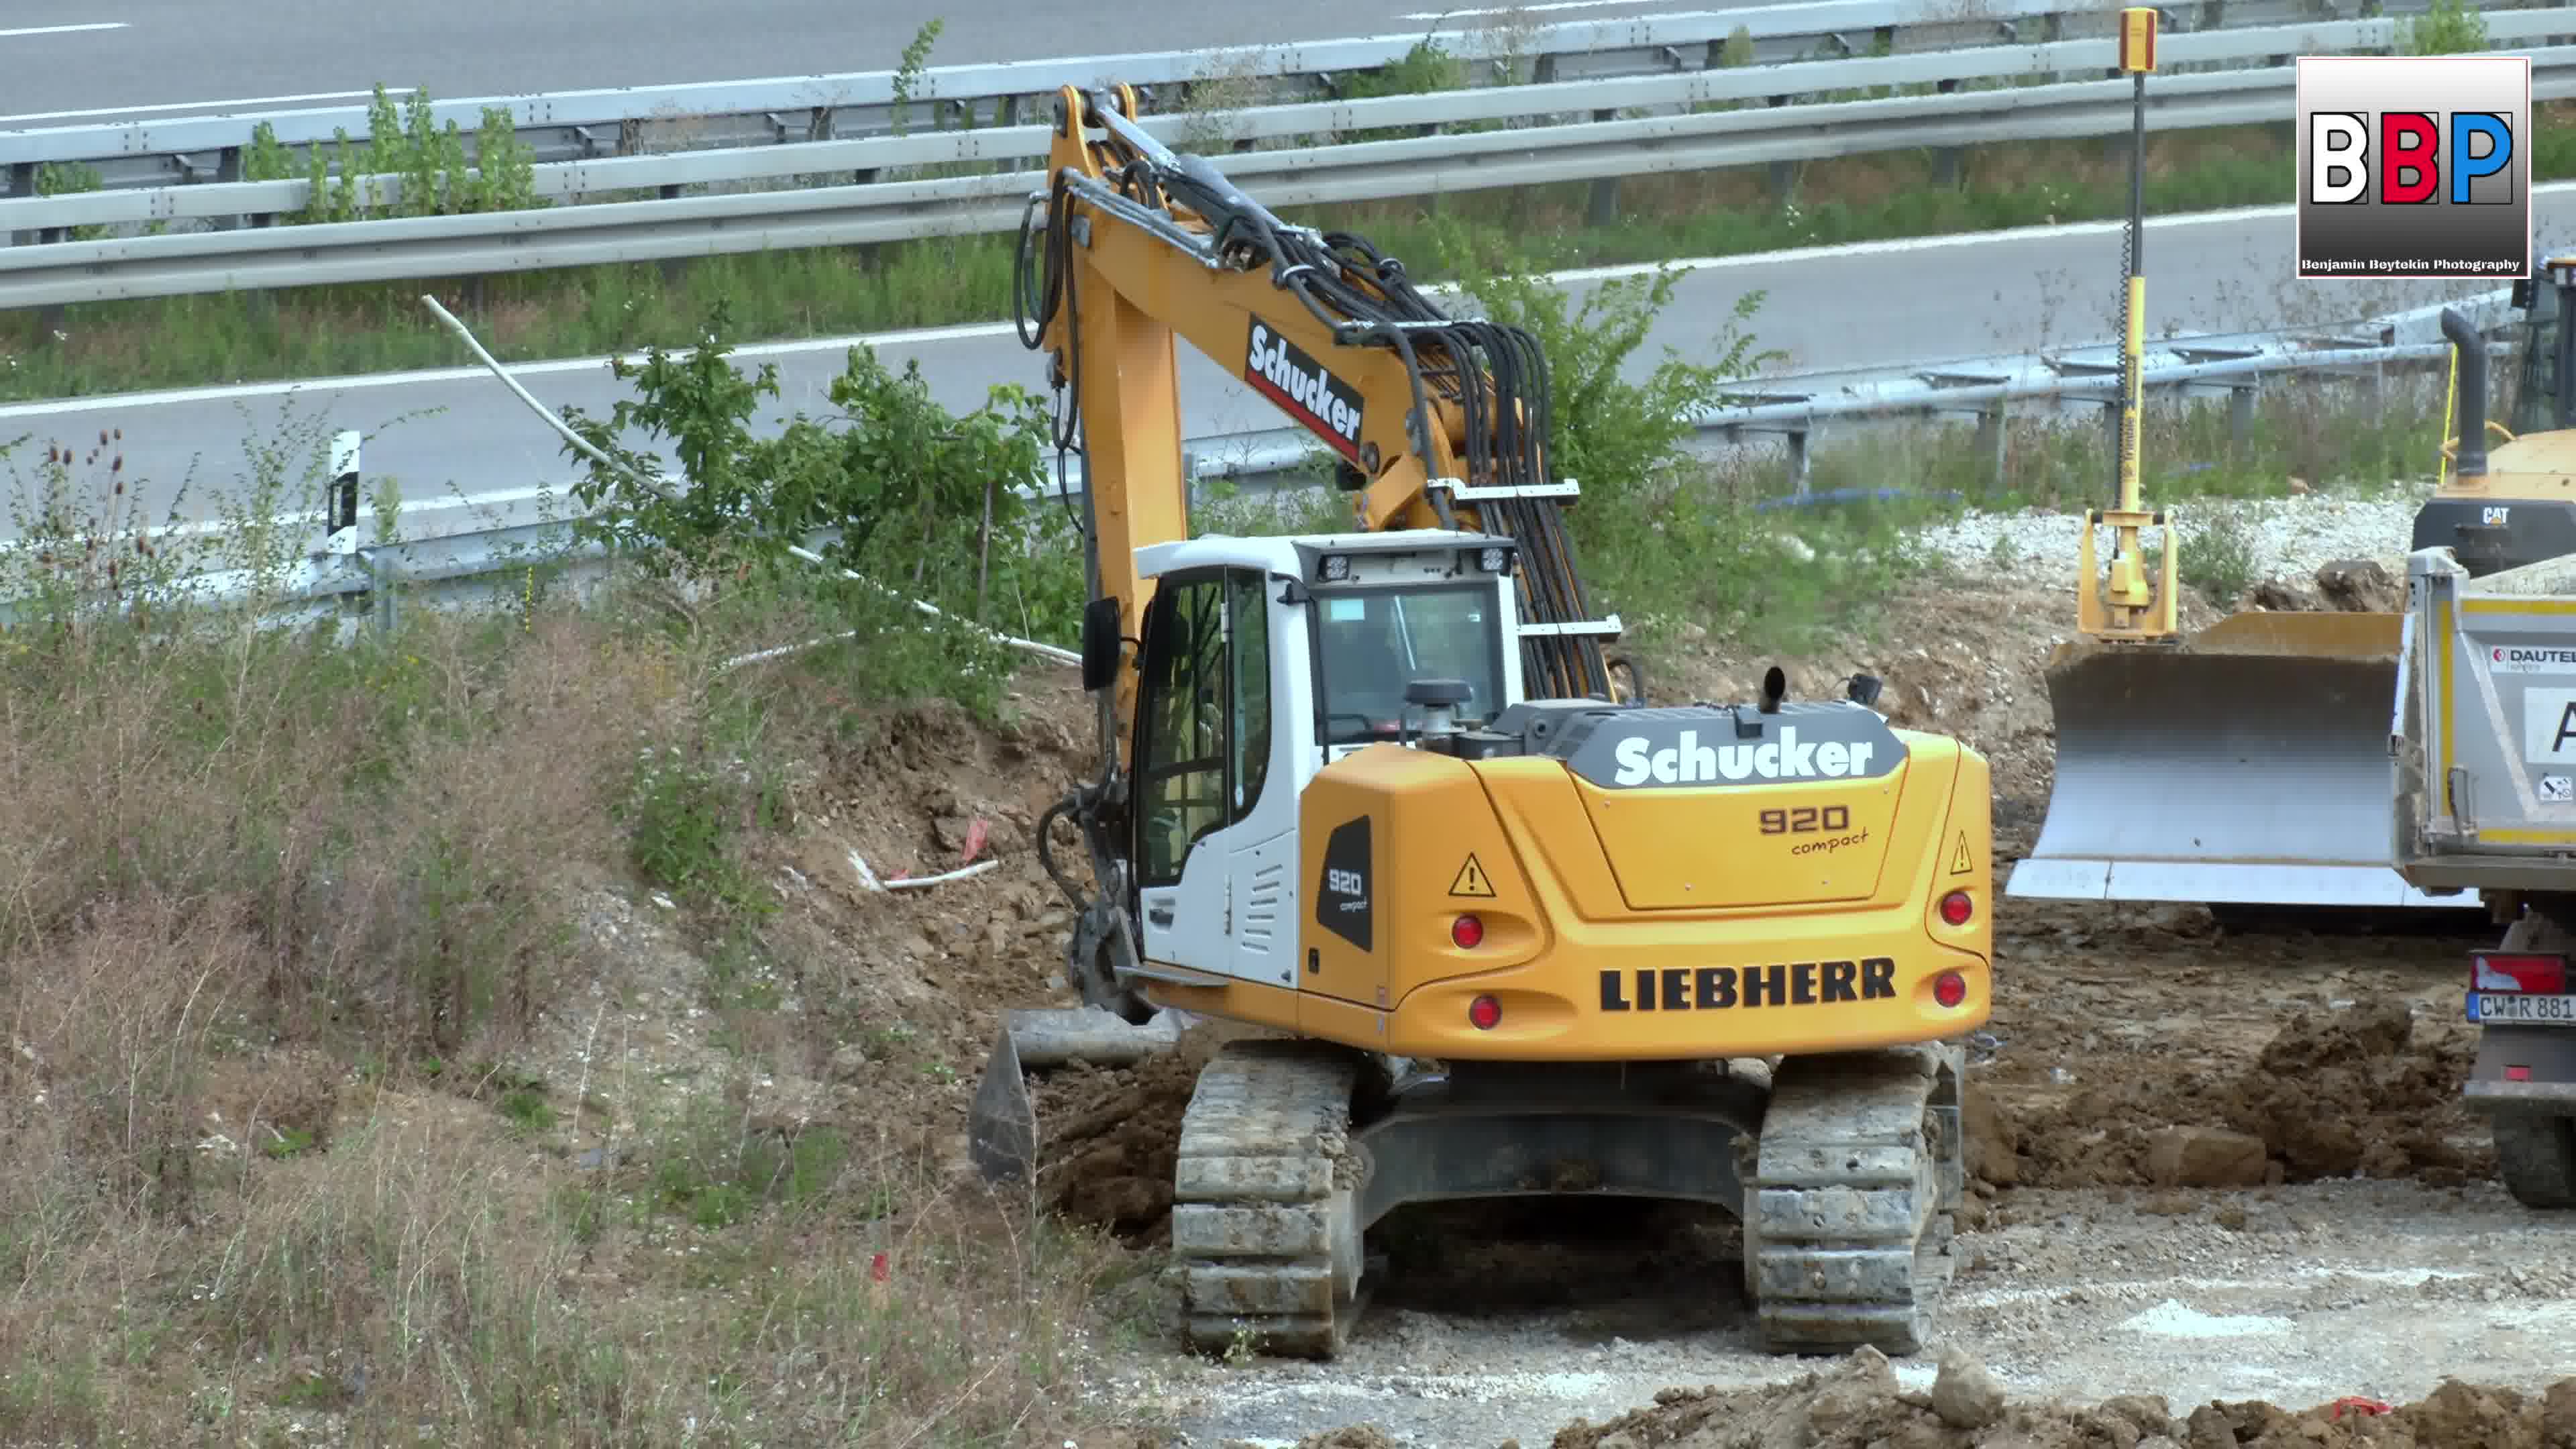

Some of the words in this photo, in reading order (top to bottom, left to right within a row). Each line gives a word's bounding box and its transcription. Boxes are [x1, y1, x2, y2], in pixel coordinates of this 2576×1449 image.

[1249, 325, 1361, 441] Schucker
[2483, 506, 2510, 525] CAT
[1615, 726, 1873, 786] Schucker
[1760, 806, 1849, 835] 920
[1792, 826, 1868, 855] compact
[1330, 869, 1362, 896] 920
[1600, 957, 1896, 1012] LIEBHERR
[2480, 997, 2506, 1016] CW
[2520, 998, 2532, 1018] R
[2538, 998, 2573, 1019] 881
